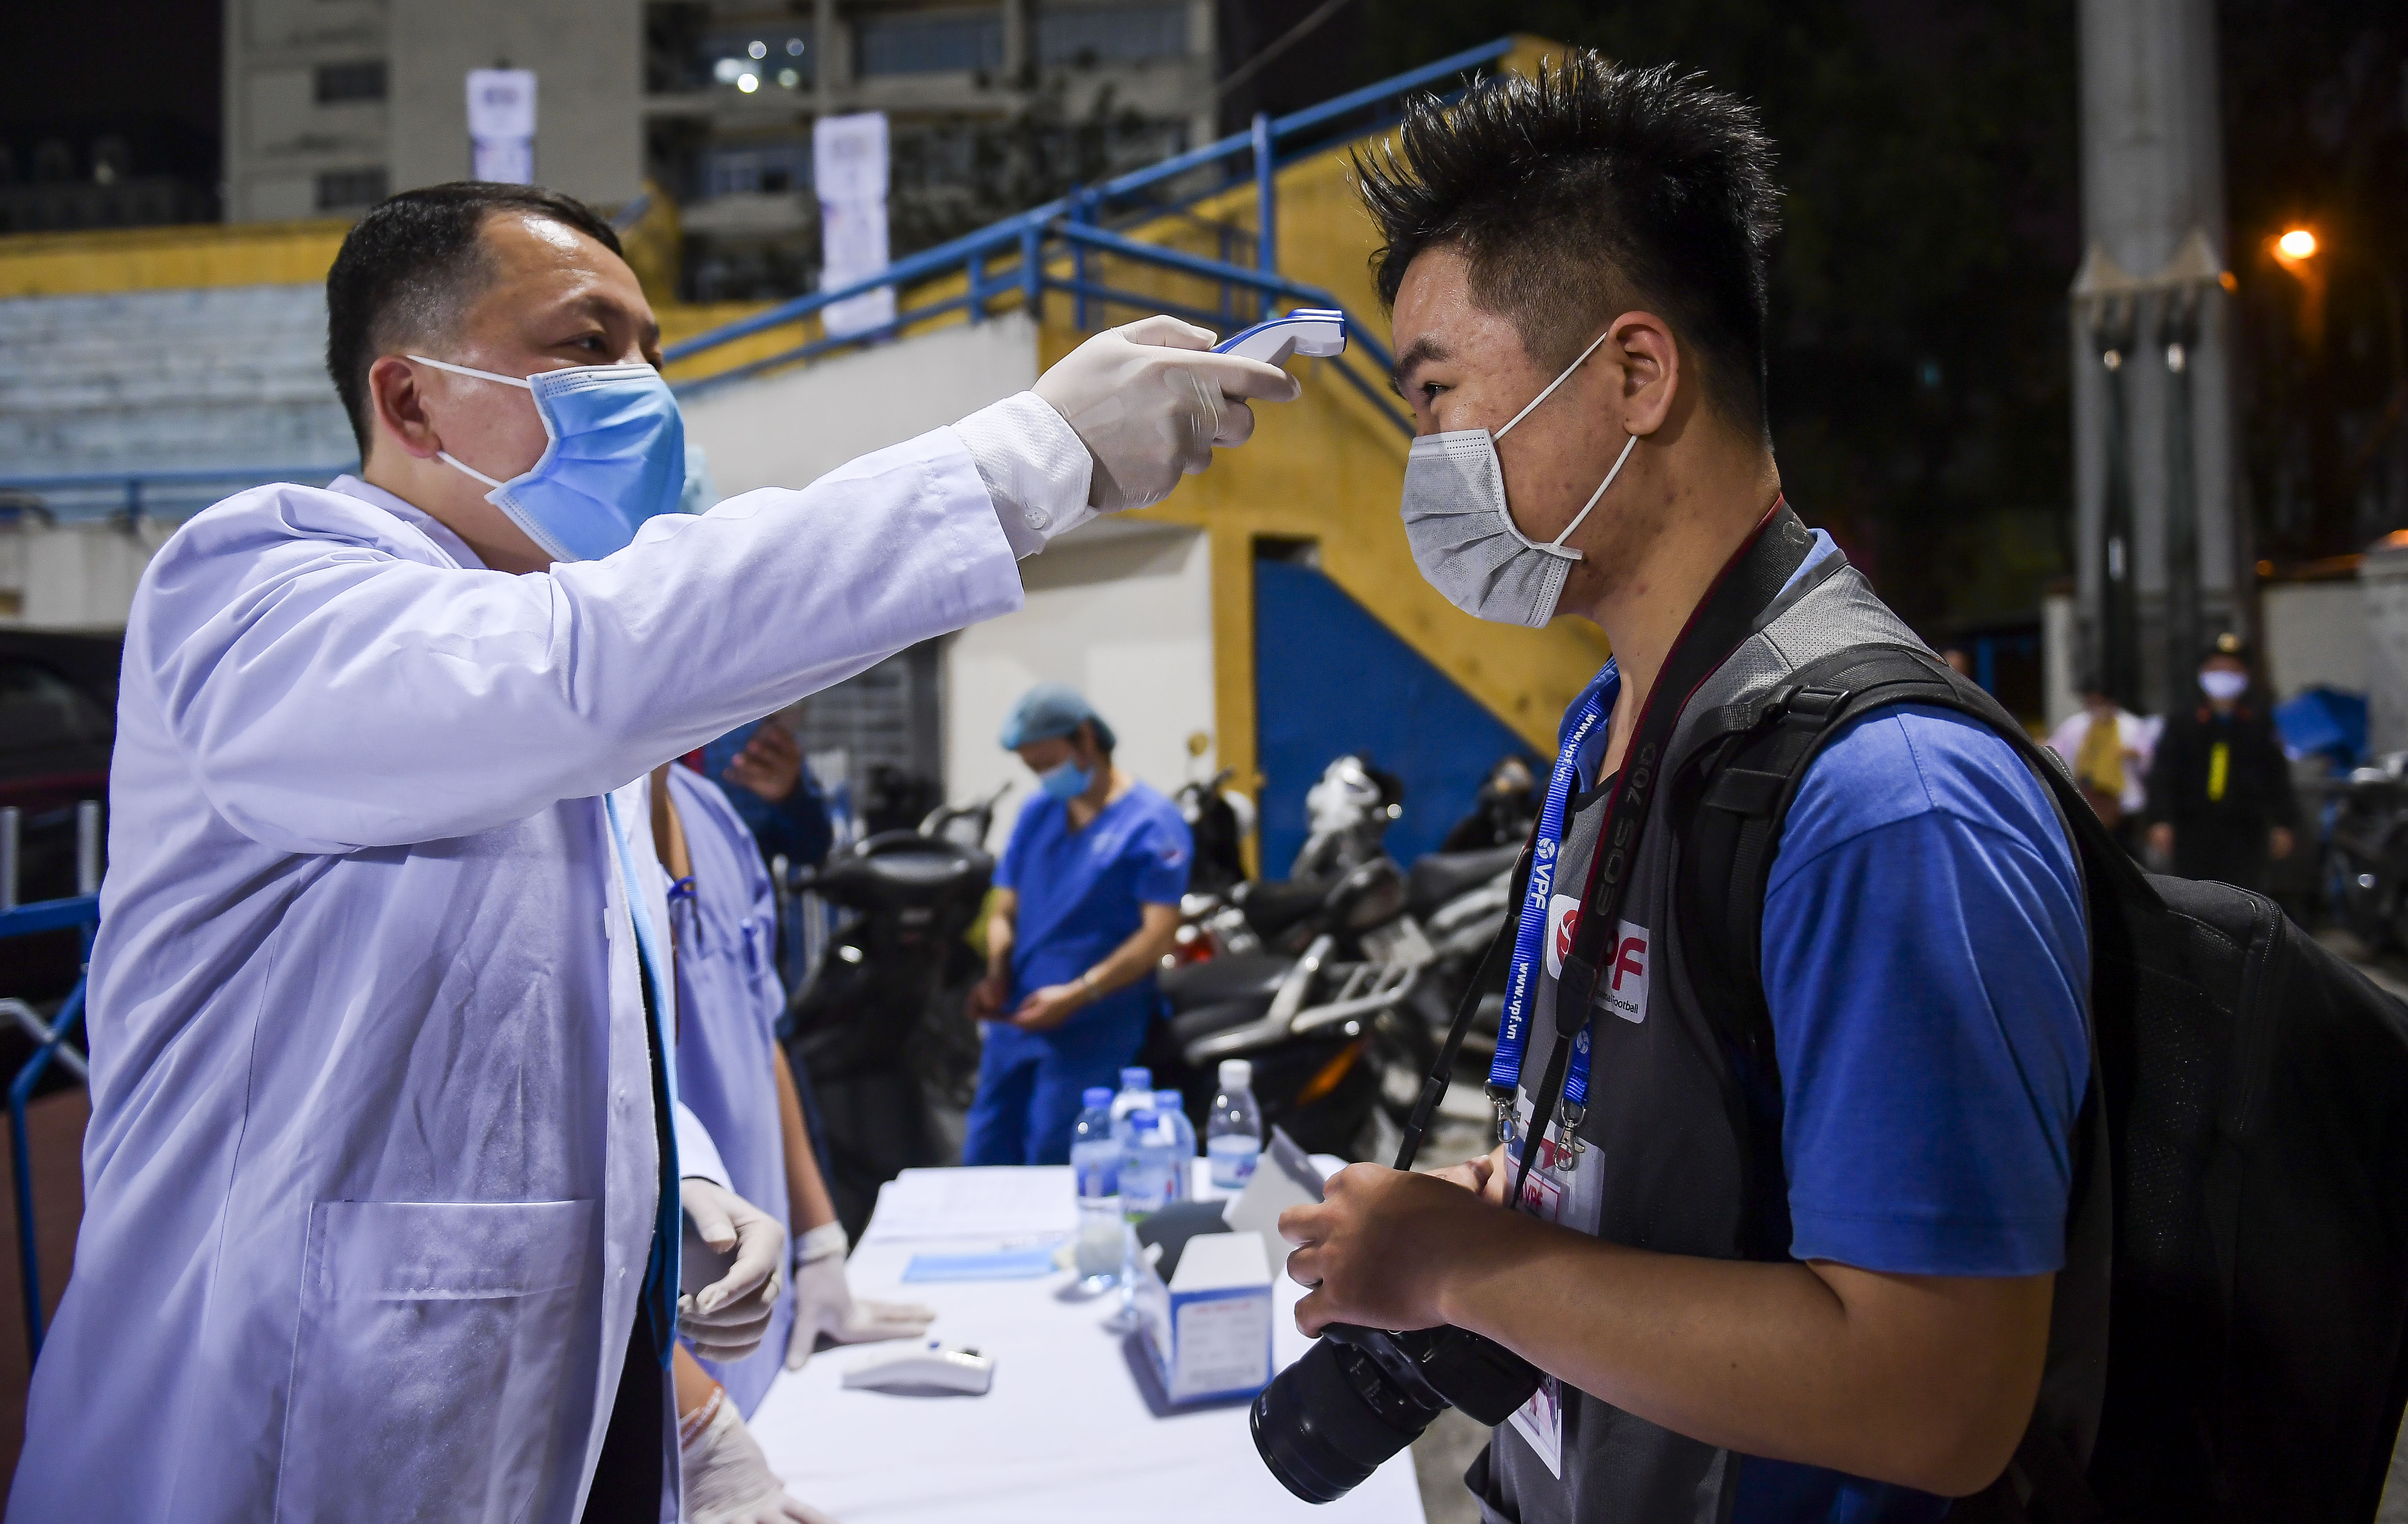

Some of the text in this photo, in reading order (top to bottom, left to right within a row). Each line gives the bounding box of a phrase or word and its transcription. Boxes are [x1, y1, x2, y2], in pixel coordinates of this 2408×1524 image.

[1556, 714, 1597, 781] www.vpf.vn
[1595, 742, 1656, 916] EOS 70D
[1530, 863, 1552, 910] VPF
[1506, 962, 1529, 1039] www.vpf.vn
